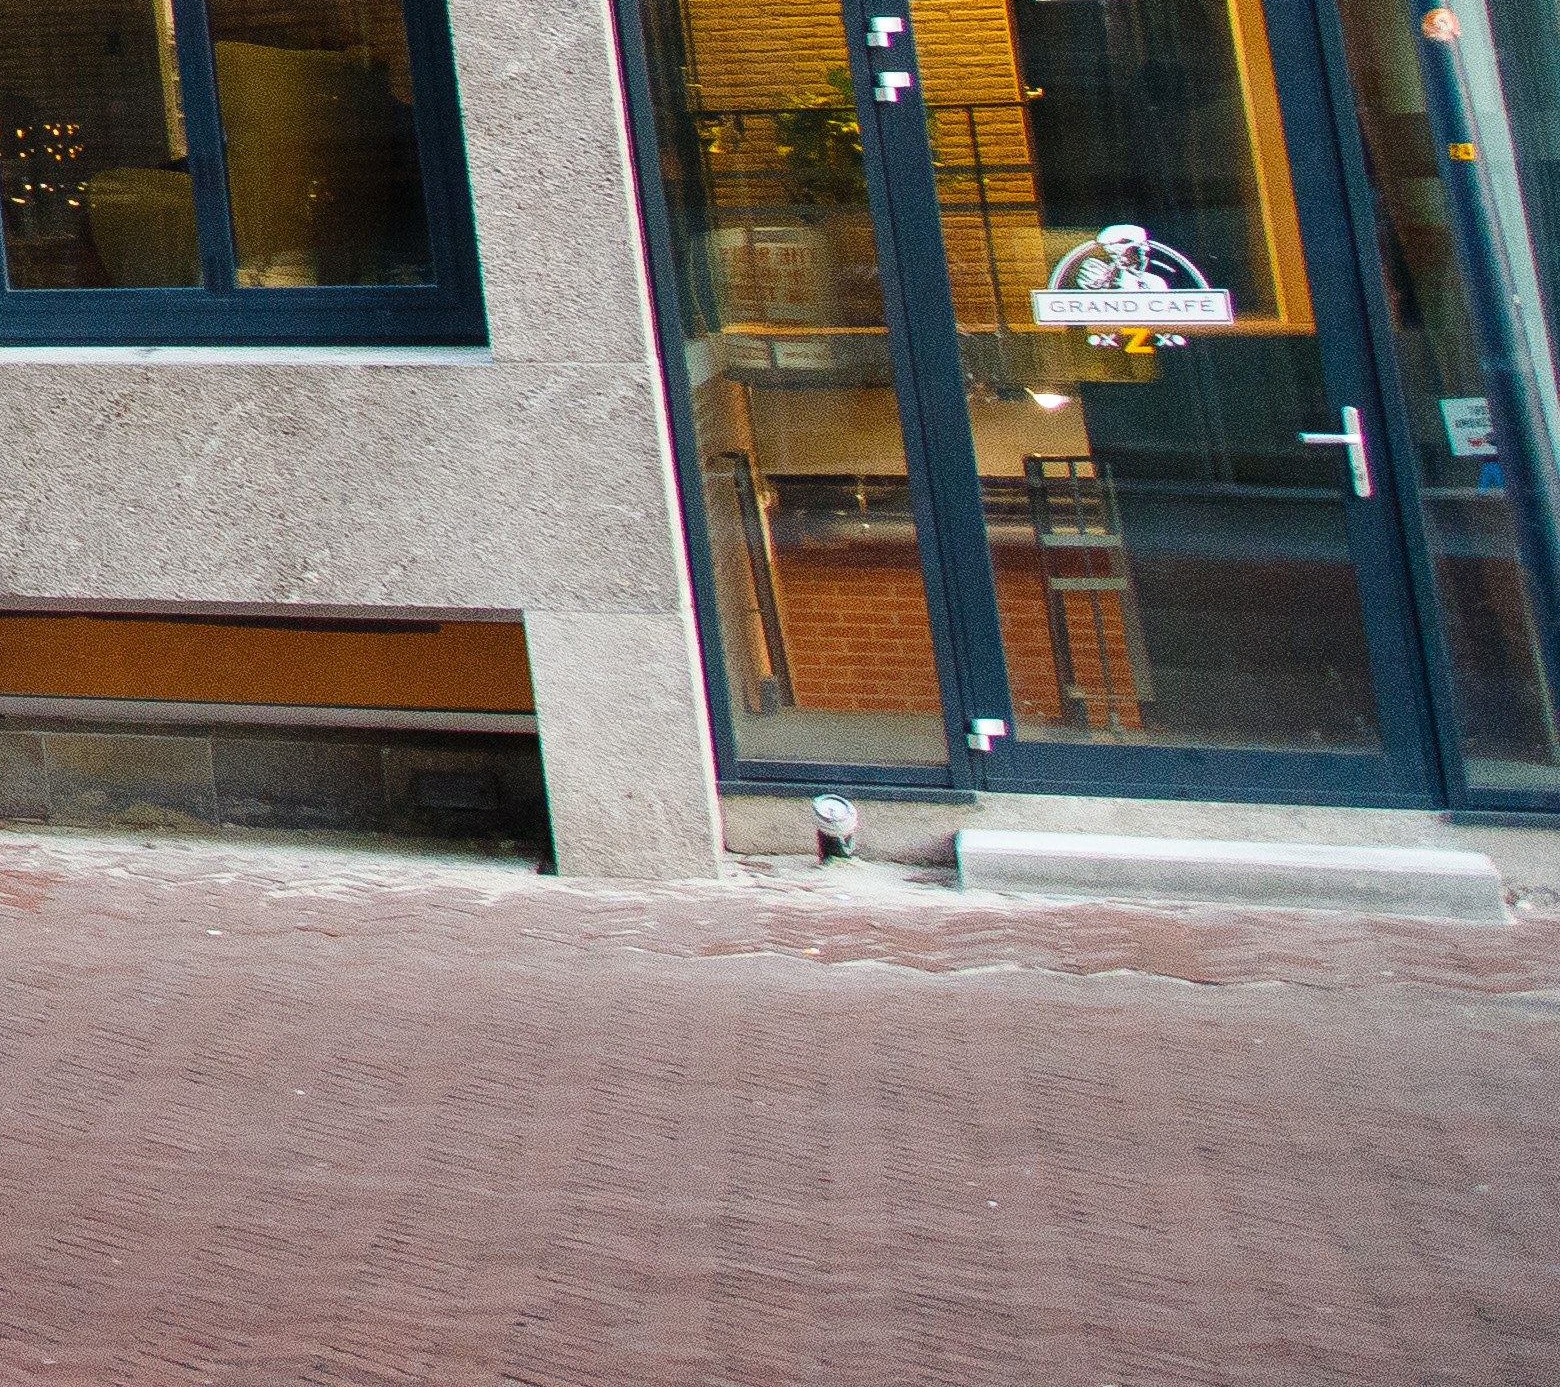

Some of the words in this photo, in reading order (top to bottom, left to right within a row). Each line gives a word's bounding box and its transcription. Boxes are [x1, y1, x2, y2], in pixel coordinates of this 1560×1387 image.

[1050, 299, 1138, 312] GRAND
[1148, 296, 1215, 312] CAFÉ
[1121, 327, 1156, 354] Z
